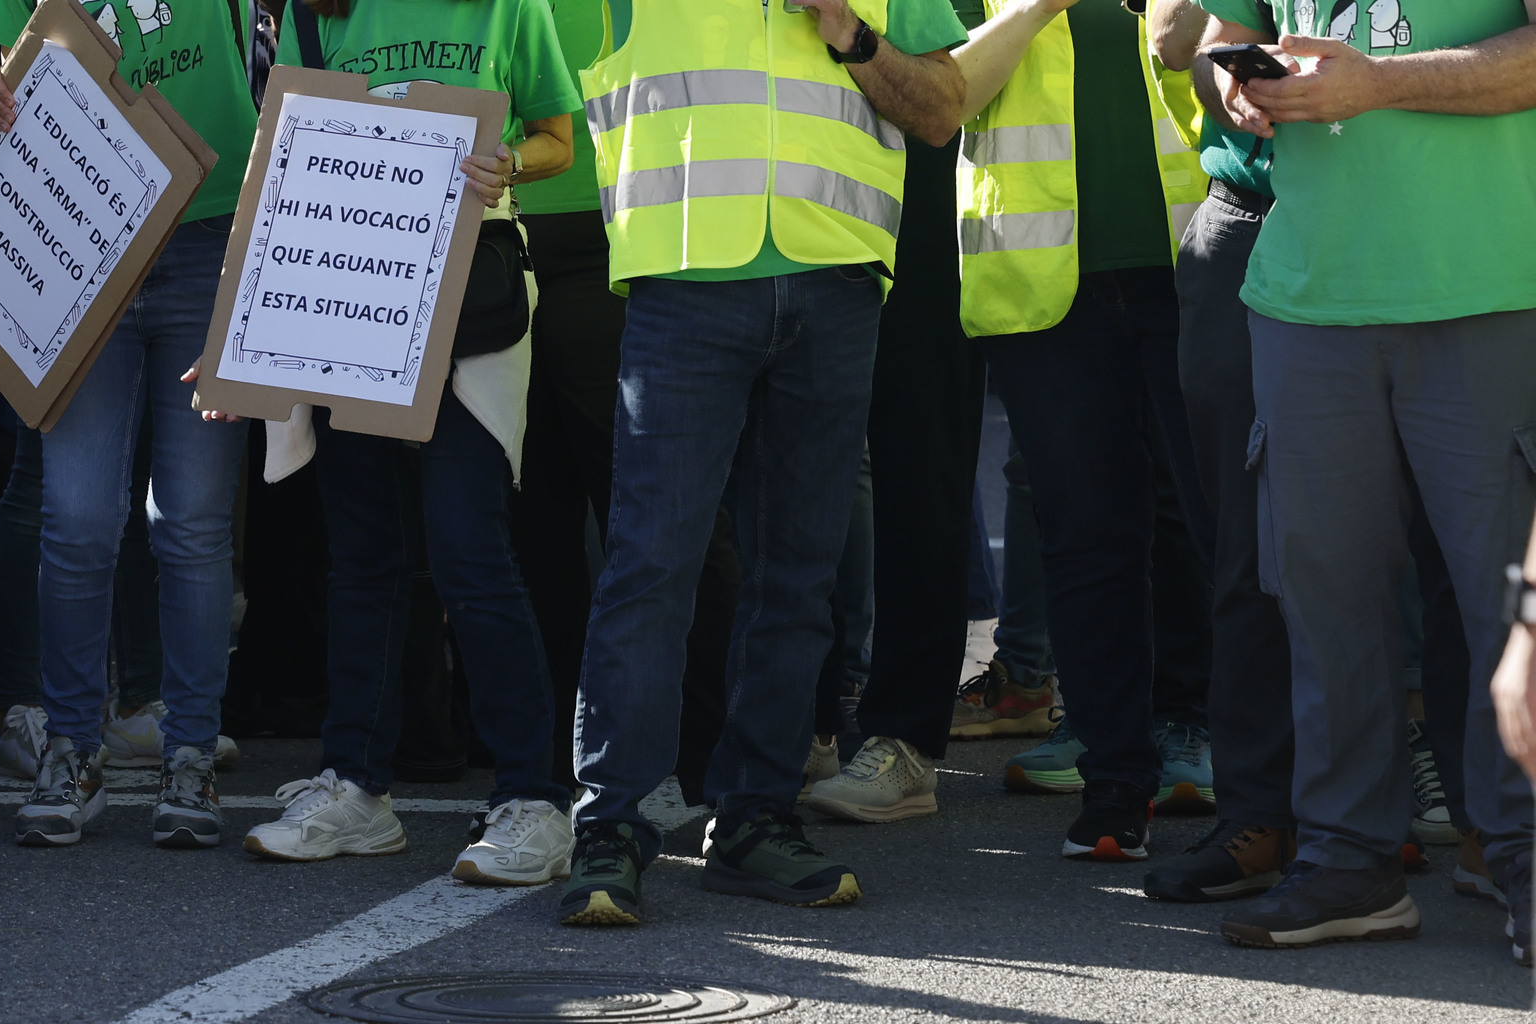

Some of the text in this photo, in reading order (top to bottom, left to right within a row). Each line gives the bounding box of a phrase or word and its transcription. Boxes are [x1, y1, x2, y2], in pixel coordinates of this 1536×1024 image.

[131, 44, 204, 89] PÚBLICA
[339, 40, 486, 74] ESTIMEM
[33, 103, 127, 217] L'EDUCACIÓ ÉS
[307, 155, 424, 186] PERQUÈ NO
[10, 132, 38, 174] UNA
[89, 228, 110, 255] DE
[278, 199, 431, 234] HI HA VOCACIÓ
[271, 246, 417, 279] QUE AGUANTE
[261, 291, 409, 326] ESTA SITUACIÓ
